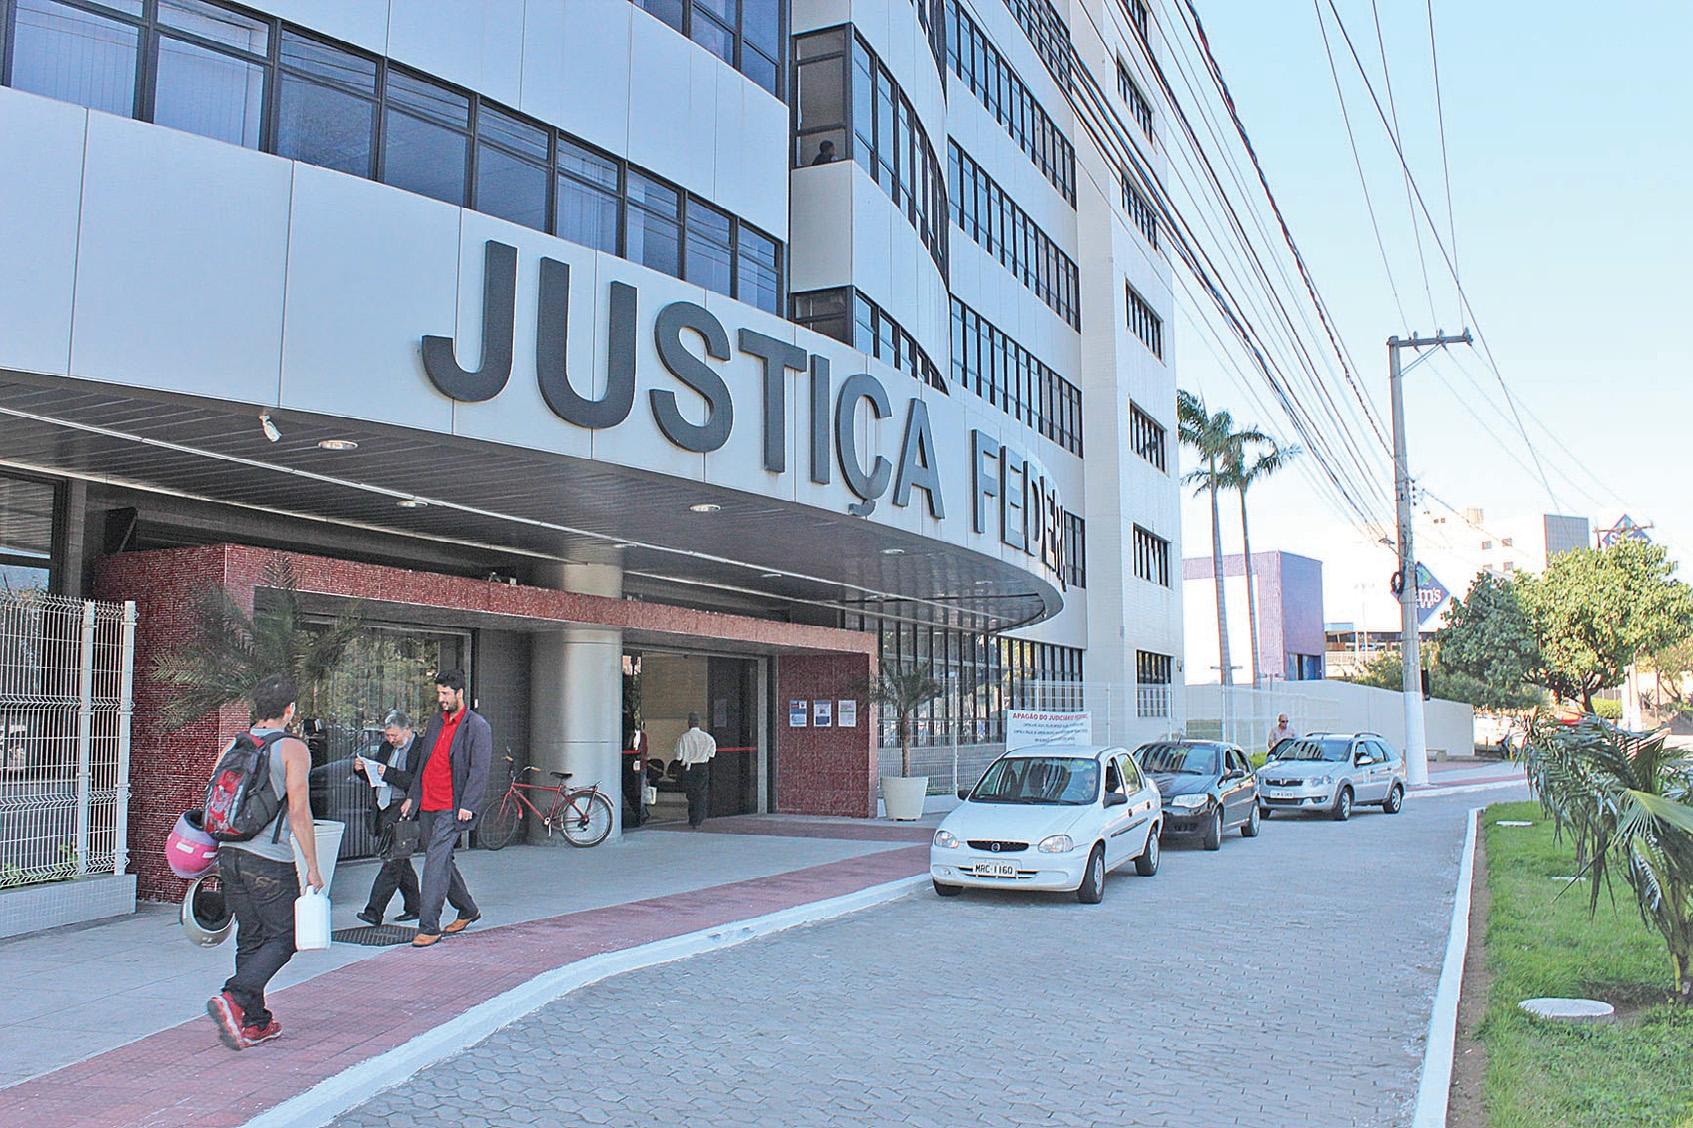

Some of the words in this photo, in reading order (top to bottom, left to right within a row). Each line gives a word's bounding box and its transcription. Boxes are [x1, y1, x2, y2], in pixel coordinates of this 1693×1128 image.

[421, 239, 946, 519] JUSTIÇA
[972, 429, 1067, 592] FEDER
[1013, 712, 1038, 720] APAGÃO
